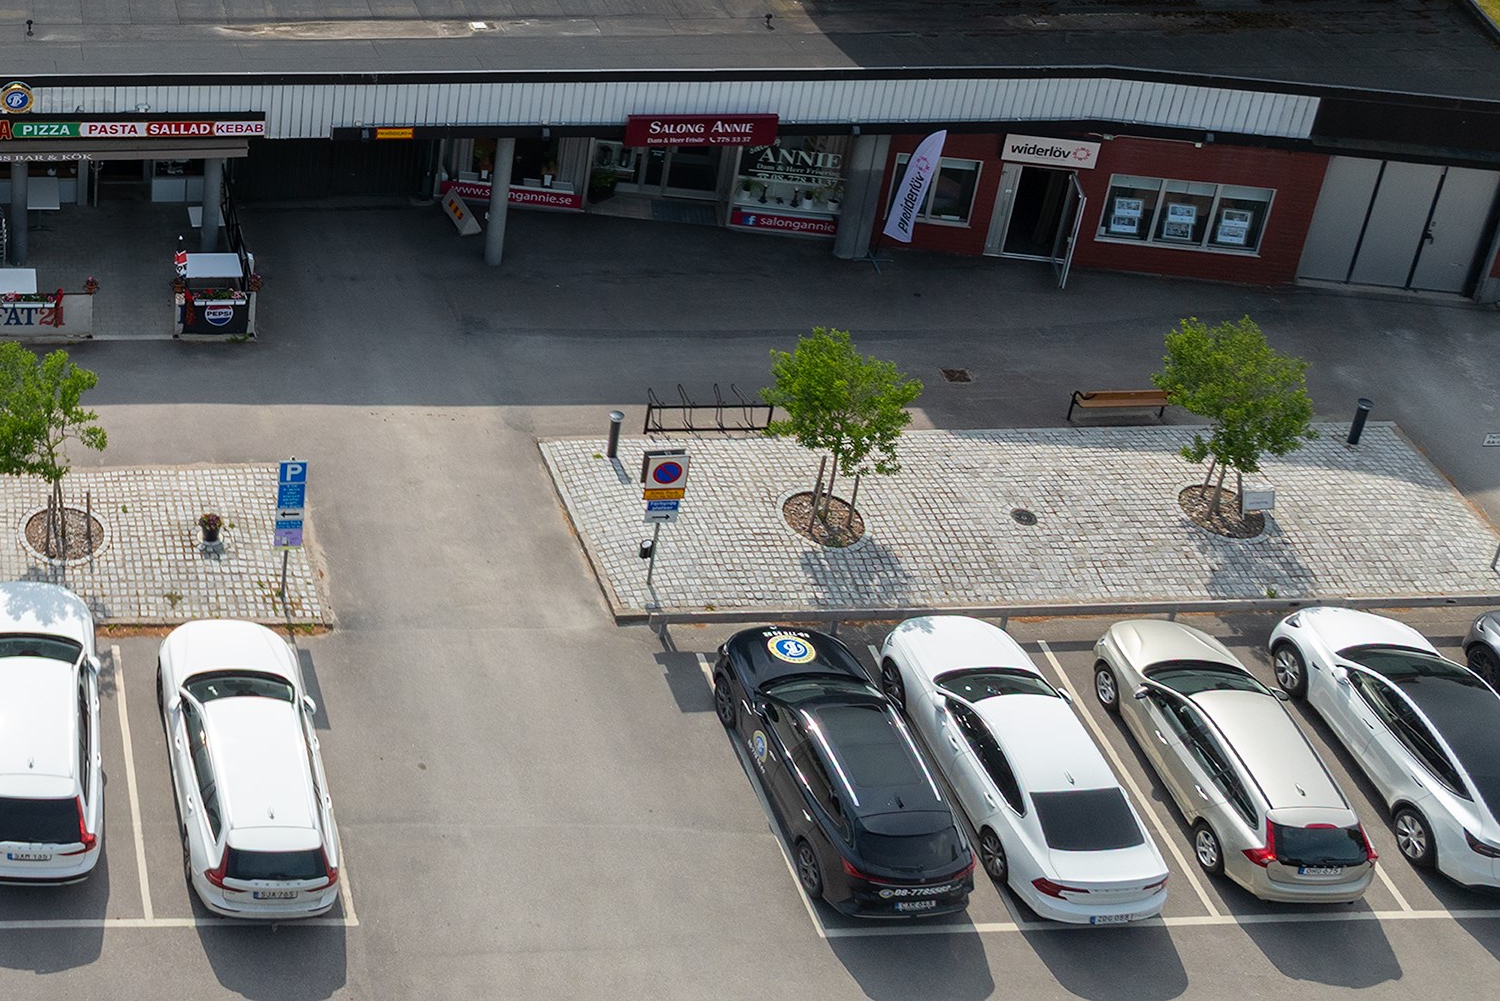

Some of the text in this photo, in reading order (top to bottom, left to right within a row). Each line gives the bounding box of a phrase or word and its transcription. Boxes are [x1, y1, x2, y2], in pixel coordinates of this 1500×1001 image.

[22, 124, 71, 136] PIZZA
[88, 124, 138, 135] PASTA
[149, 123, 211, 135] SALLAD
[216, 123, 264, 133] KEBAB
[649, 120, 754, 134] SALONG ANNIE
[1011, 143, 1071, 158] widerlöv
[757, 147, 842, 169] ANNIE
[451, 185, 572, 205] www.sngannie.se
[759, 216, 836, 232] salongannie
[286, 463, 303, 482] P
